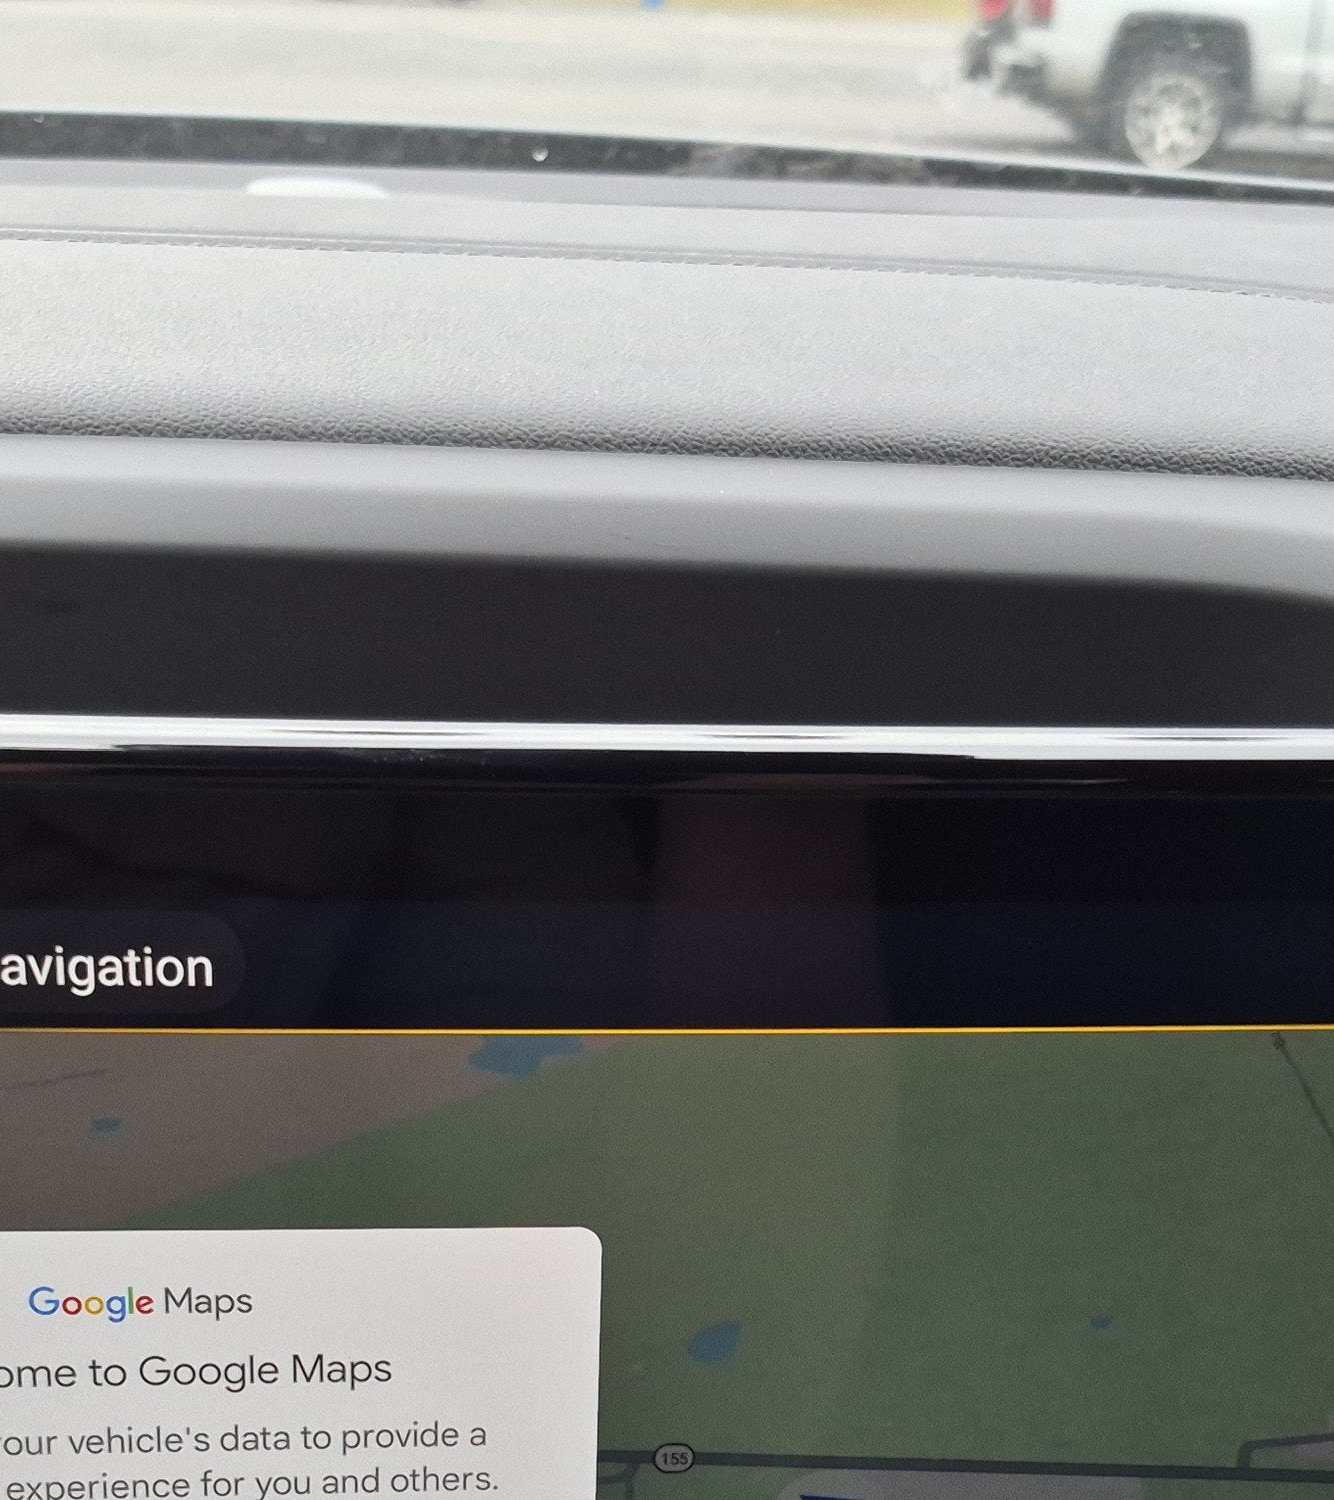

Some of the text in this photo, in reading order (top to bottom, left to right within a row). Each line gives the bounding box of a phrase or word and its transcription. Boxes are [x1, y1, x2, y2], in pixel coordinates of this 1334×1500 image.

[28, 1286, 253, 1324] Google Maps
[87, 1359, 128, 1387] to
[139, 1355, 280, 1394] Google
[292, 1353, 392, 1391] Maps
[68, 1425, 211, 1456] vehicle's
[219, 1424, 291, 1452] data
[300, 1426, 332, 1450] to
[342, 1420, 459, 1456] provide
[470, 1427, 487, 1447] a
[661, 1452, 689, 1465] 155
[200, 1469, 245, 1497] for
[322, 1466, 380, 1495] and
[390, 1465, 498, 1493] others.
